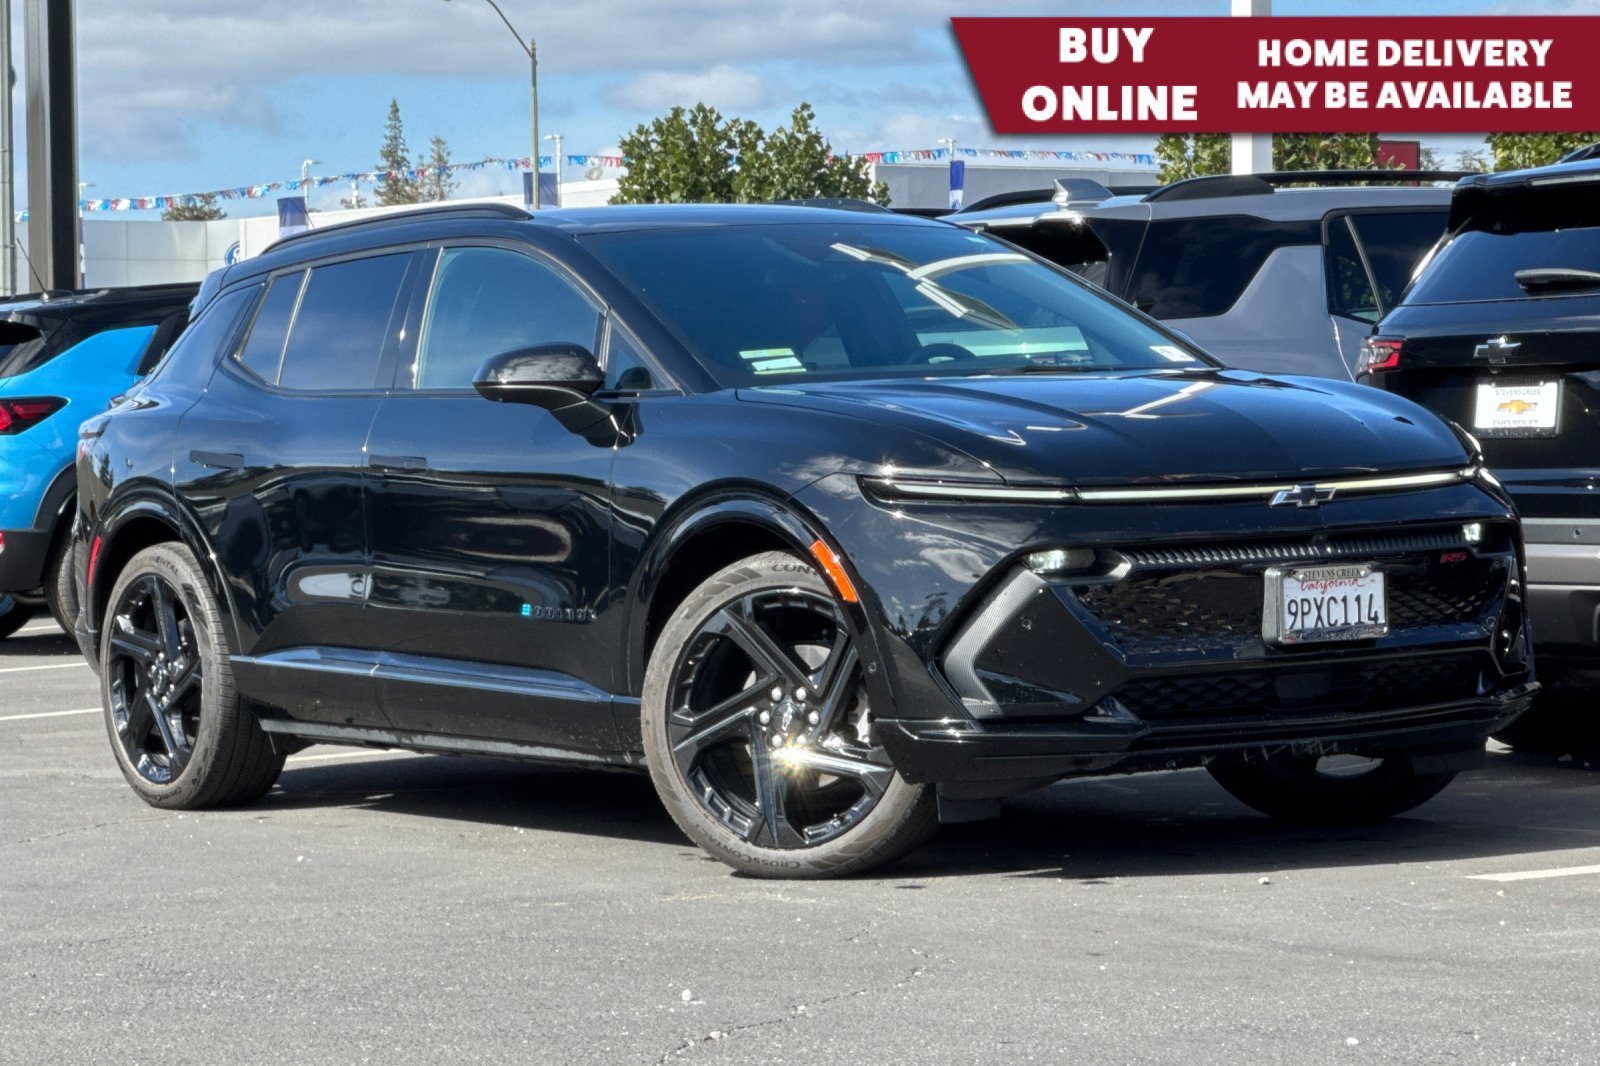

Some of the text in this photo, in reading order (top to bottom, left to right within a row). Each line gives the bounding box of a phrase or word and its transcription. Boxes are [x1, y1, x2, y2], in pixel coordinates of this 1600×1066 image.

[1523, 388, 1542, 396] CREEK
[1303, 567, 1361, 579] STEVENS CREEK
[1301, 577, 1365, 594] California
[1287, 593, 1379, 630] 9PXC114
